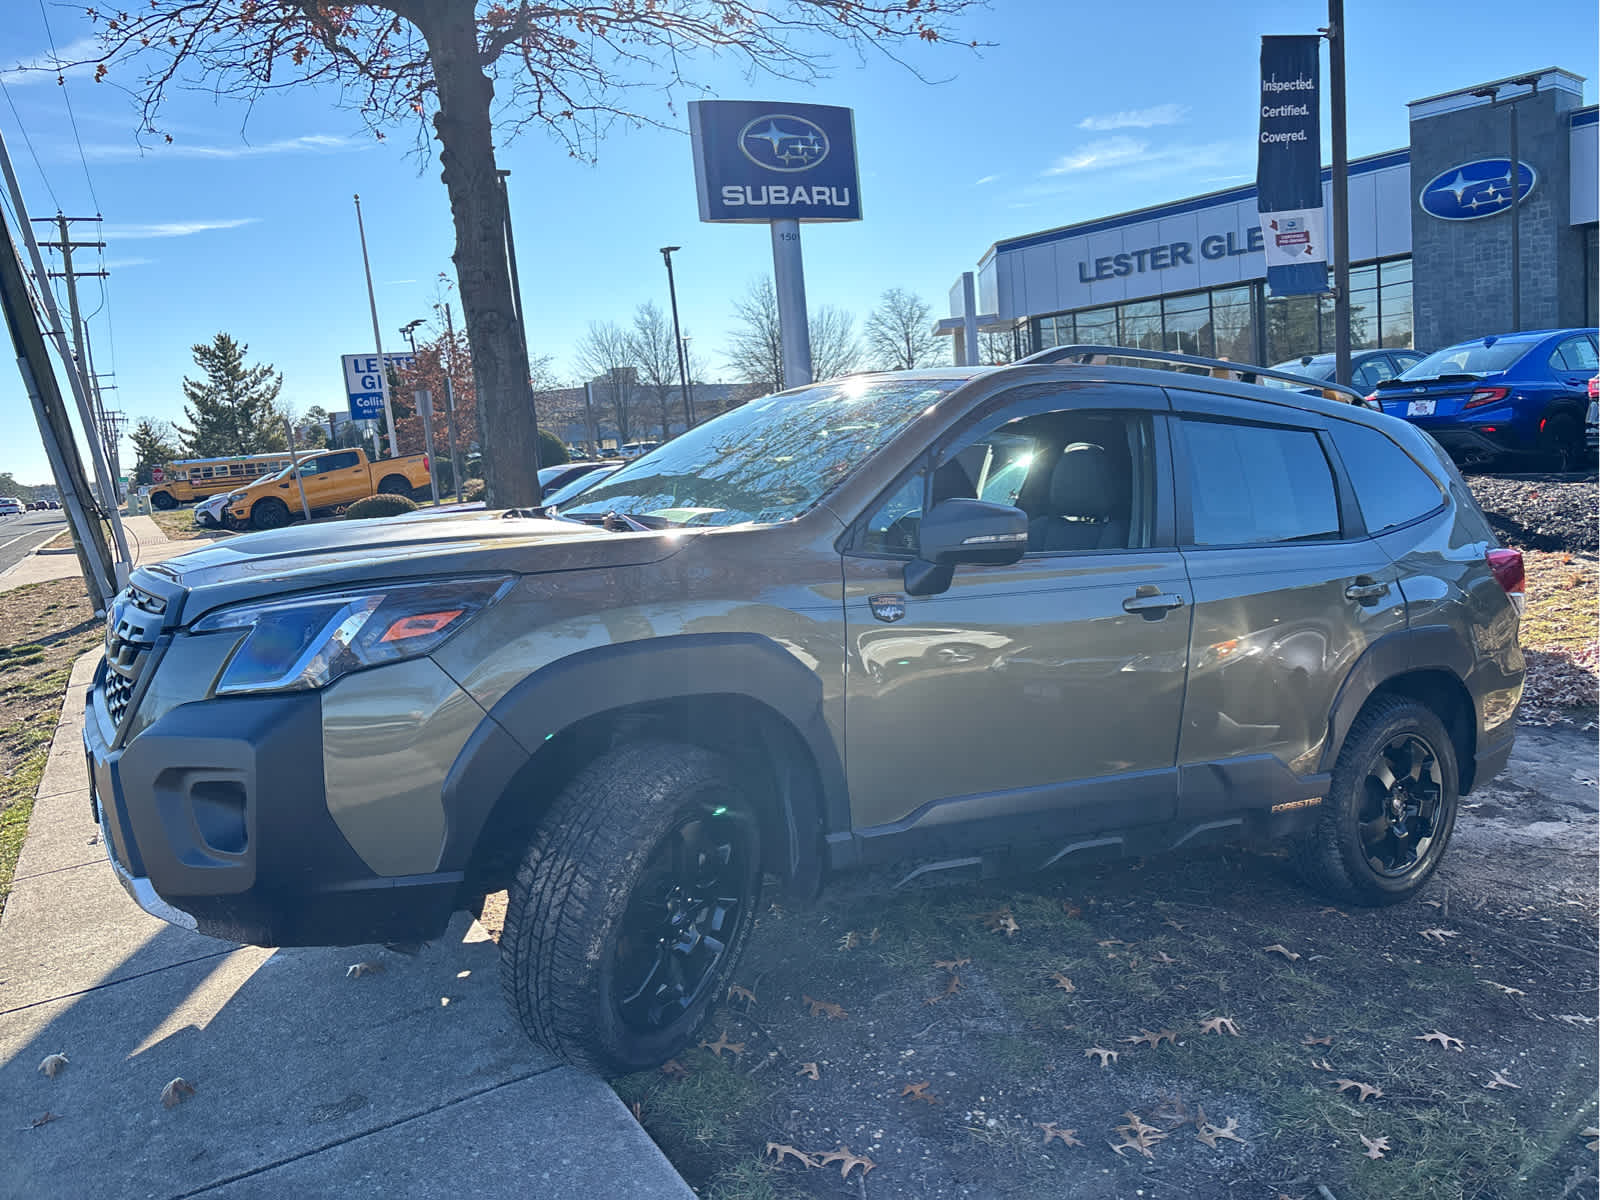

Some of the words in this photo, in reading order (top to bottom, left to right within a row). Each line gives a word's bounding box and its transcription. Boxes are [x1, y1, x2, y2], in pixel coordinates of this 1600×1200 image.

[1262, 79, 1315, 93] Inspected.
[1261, 104, 1310, 118] Certified.
[1260, 130, 1308, 143] Covered.
[721, 185, 850, 206] SUBARU
[1078, 242, 1194, 284] LESTER
[1271, 797, 1323, 813] FORESTER
